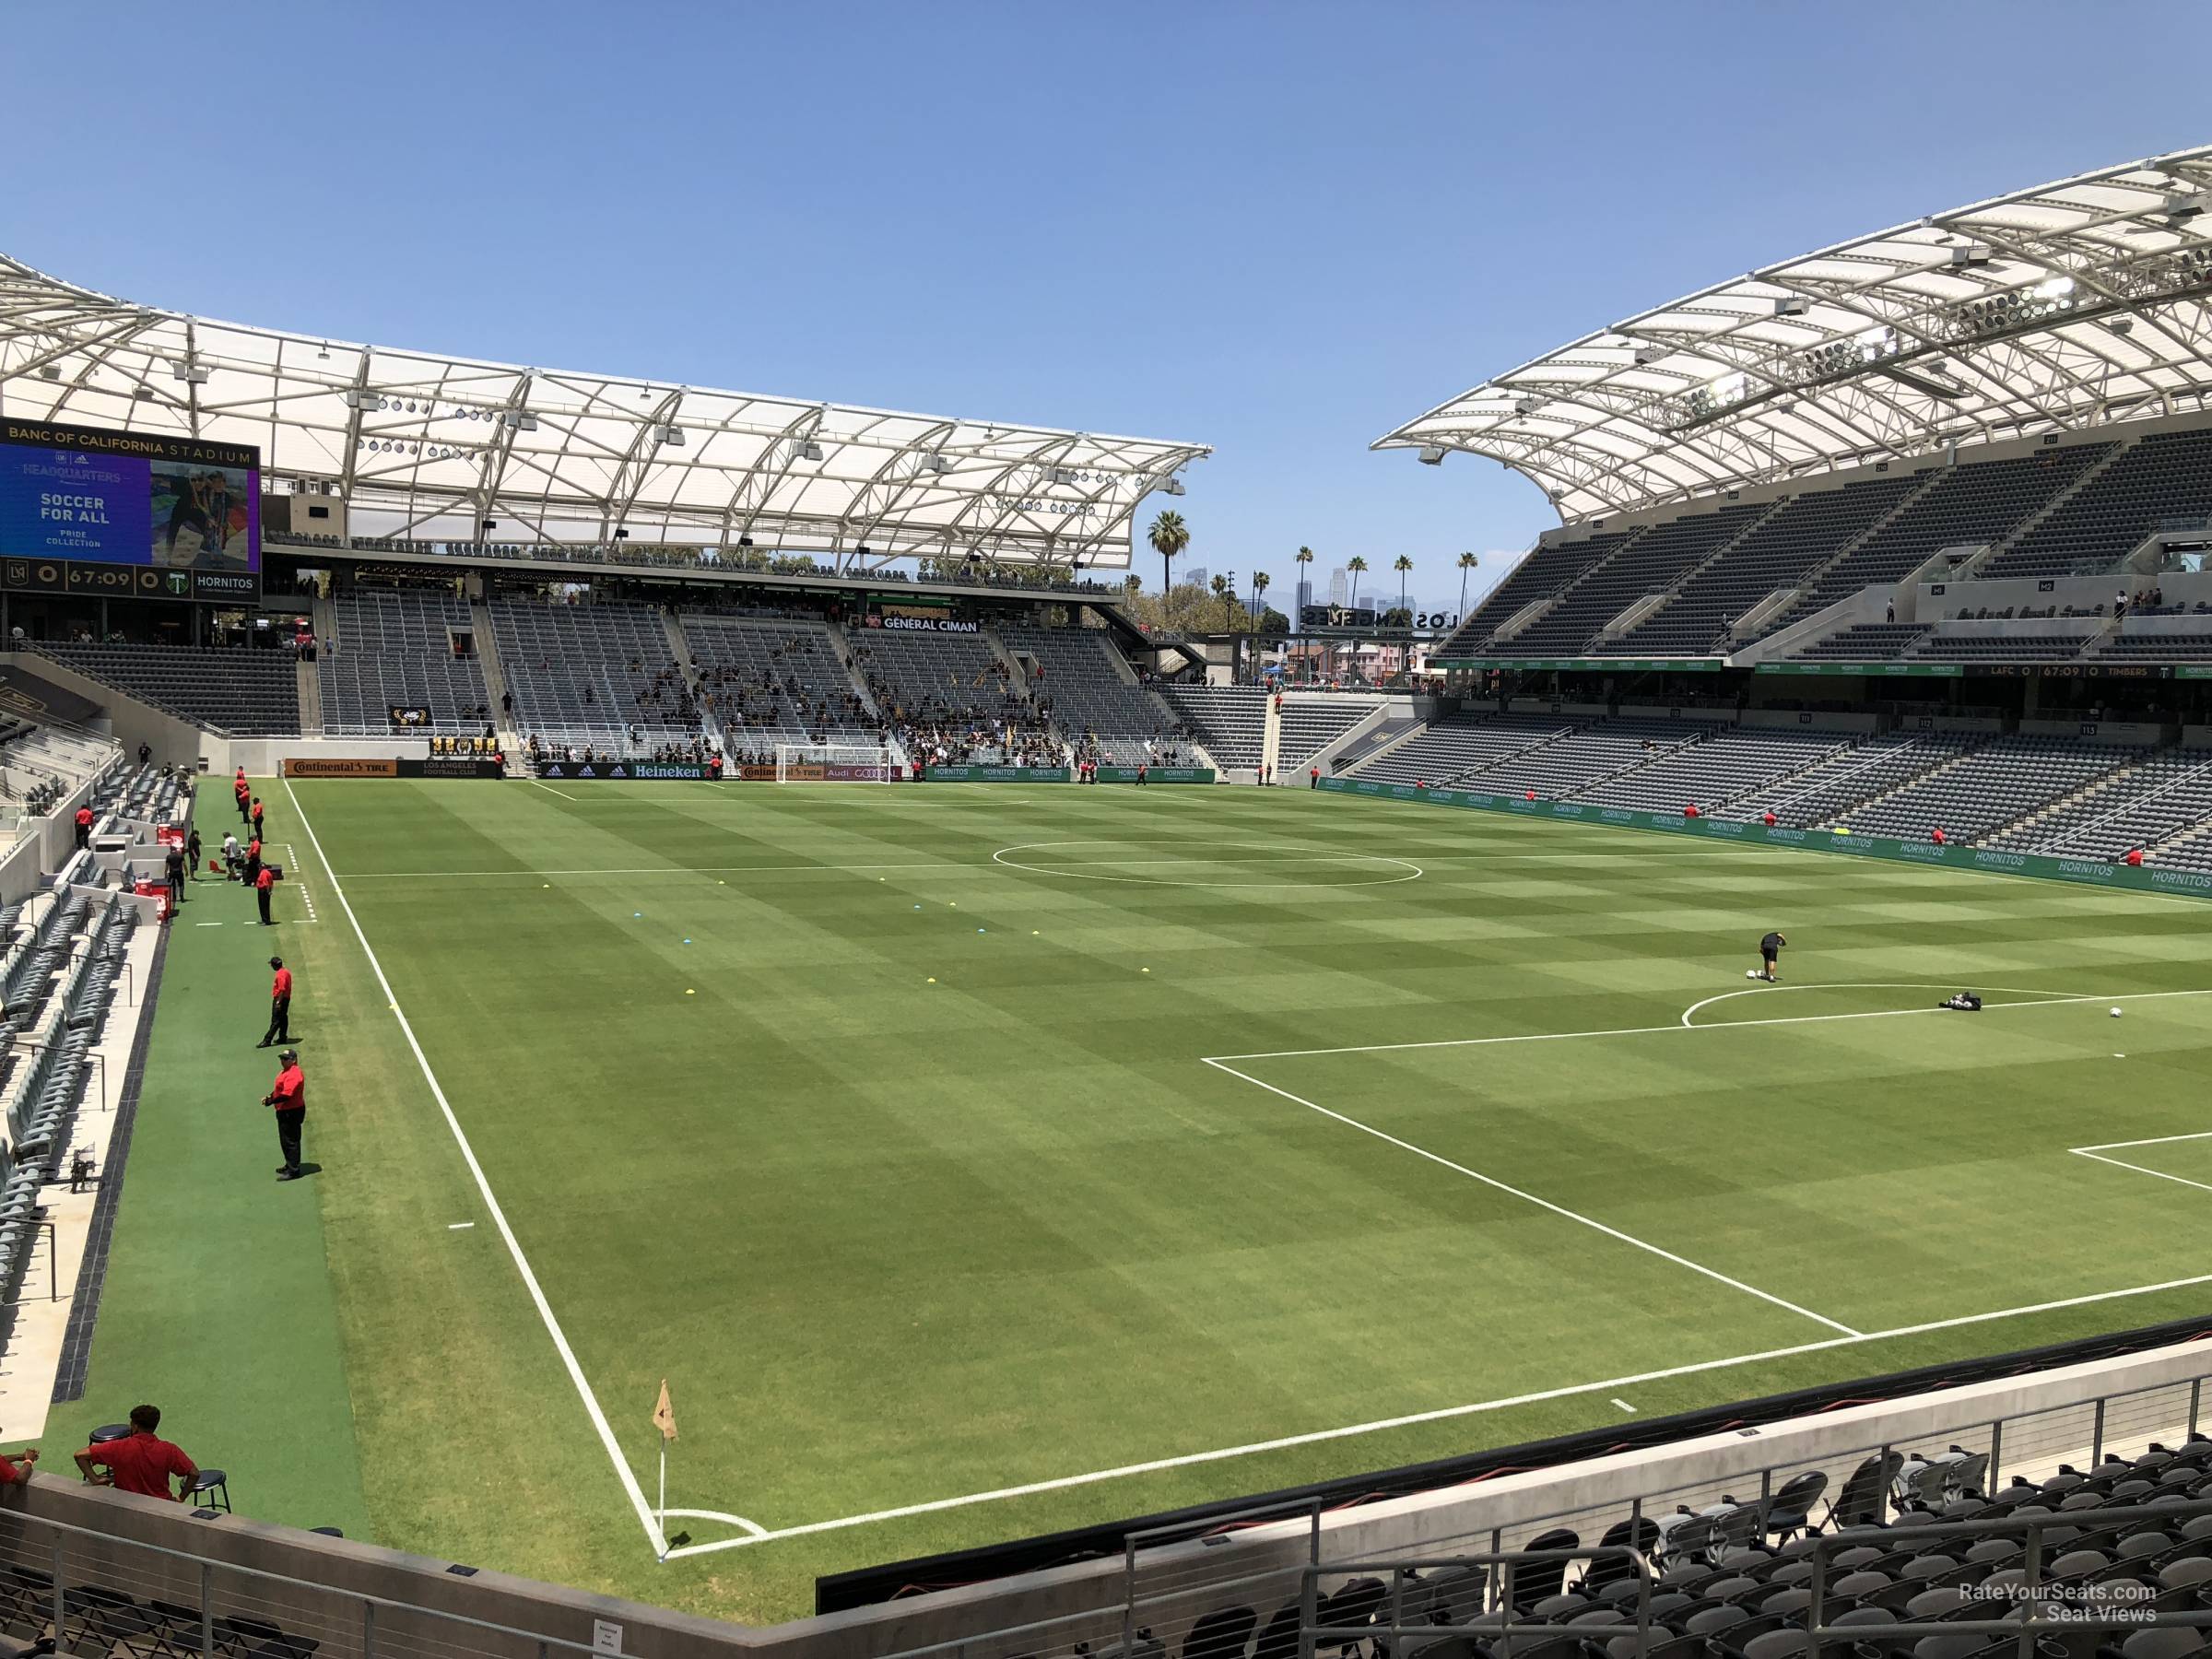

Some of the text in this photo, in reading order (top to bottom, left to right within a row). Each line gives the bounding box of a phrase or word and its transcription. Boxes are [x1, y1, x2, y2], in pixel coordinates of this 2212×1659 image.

[9, 427, 250, 463] BANC OF CALIFORNIA STADIUM
[23, 464, 121, 483] HEADQUARTERS
[41, 493, 104, 510] SOCCER
[41, 508, 110, 524] FOR ALL
[60, 530, 87, 538] PRIDE
[46, 537, 100, 547] COLLECTION
[39, 565, 57, 582] 0
[69, 570, 129, 586] 67:09
[140, 571, 159, 589] 0
[197, 576, 253, 589] HORNITOS
[939, 619, 977, 632] CIMAN
[1991, 666, 2014, 676] LAFC
[2043, 666, 2079, 677] 67:09
[2108, 667, 2148, 677] TIMBERS
[294, 760, 354, 773] Continental
[635, 765, 700, 778] Heineken
[827, 769, 849, 777] Audi
[1509, 799, 1537, 809] HORNITOS
[1553, 804, 1583, 815] HORNITOS
[1600, 809, 1634, 820] HORNITOS
[1652, 815, 1687, 827] HORNITOS
[1707, 820, 1744, 833] HORNITOS
[1767, 828, 1806, 841] HORNITOS
[1830, 834, 1874, 848] HORNITOS
[1900, 842, 1947, 856] HORNITOS
[1975, 851, 2026, 866] HORNITOS
[2058, 861, 2114, 877] HORNITOS
[2152, 871, 2211, 888] HORNITOS
